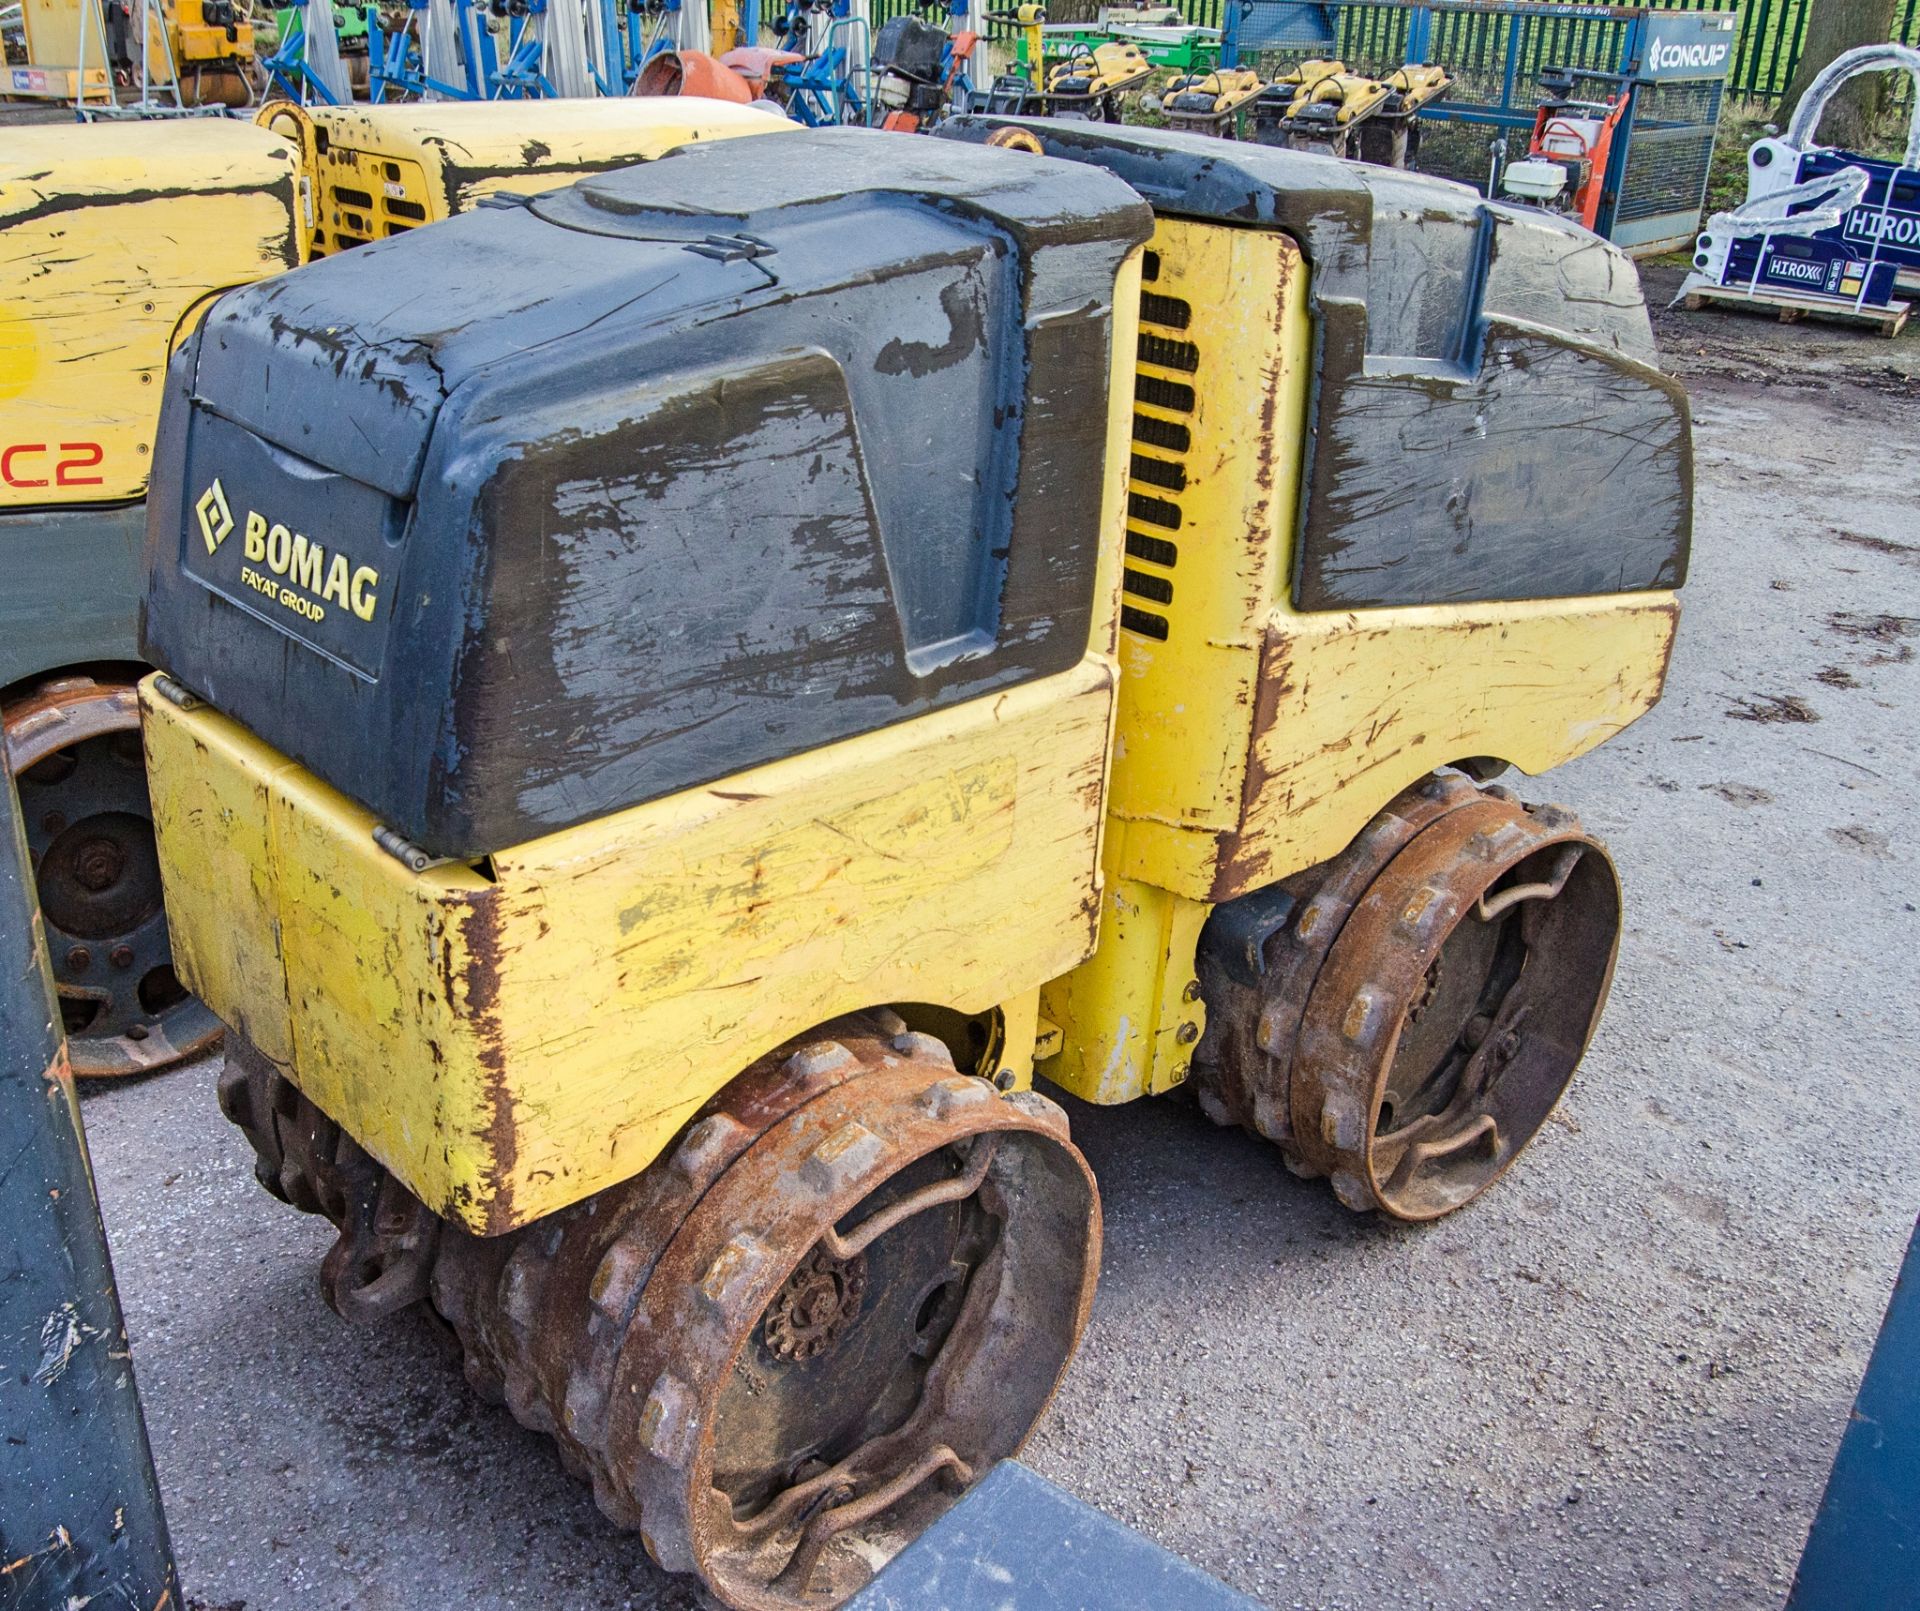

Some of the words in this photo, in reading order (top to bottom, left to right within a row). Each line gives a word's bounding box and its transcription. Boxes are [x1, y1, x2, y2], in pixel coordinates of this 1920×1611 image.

[1660, 44, 1726, 68] CONQUIP
[1770, 260, 1815, 280] HIROX
[1, 442, 104, 488] C2
[244, 510, 379, 622] BOMAG
[241, 566, 279, 600] FAYAT
[280, 588, 325, 623] GROUP
